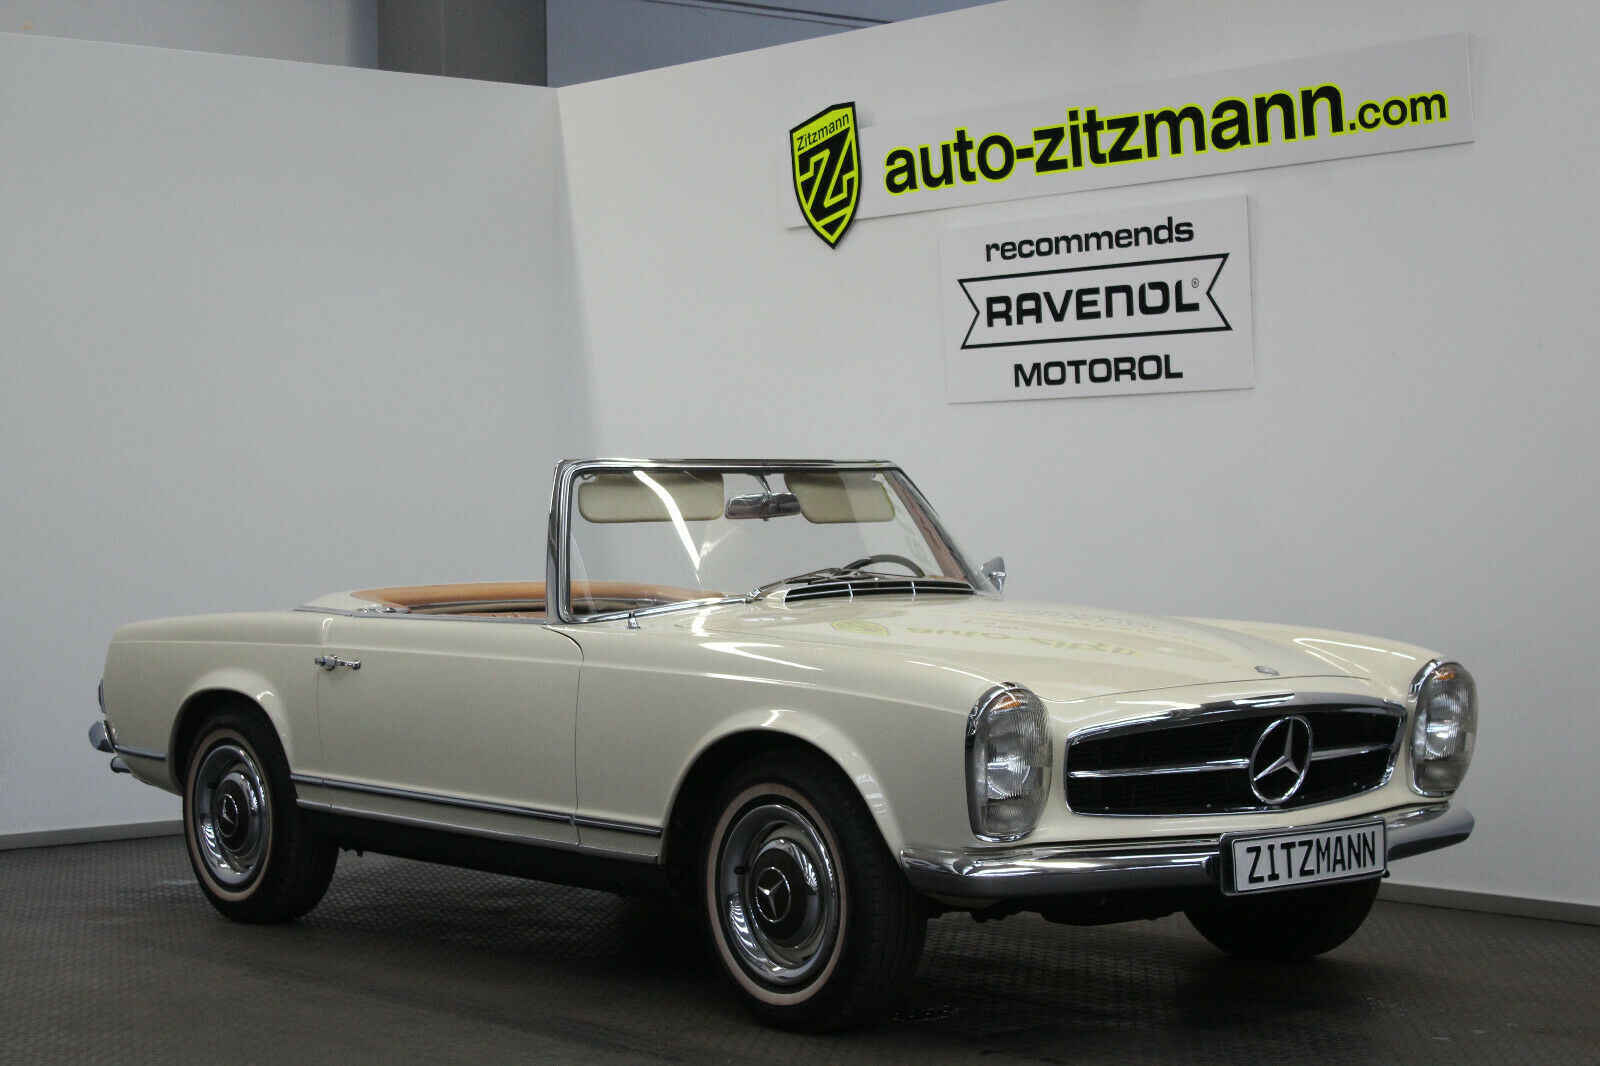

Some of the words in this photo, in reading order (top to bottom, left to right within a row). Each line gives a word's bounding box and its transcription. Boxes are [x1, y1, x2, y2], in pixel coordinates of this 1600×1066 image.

[796, 113, 850, 150] Zitzmann
[884, 83, 1448, 194] auto-zitzmann.com
[985, 217, 1194, 263] recommends
[1014, 354, 1184, 388] MOTOROL
[1246, 830, 1376, 884] ZITZMANN
